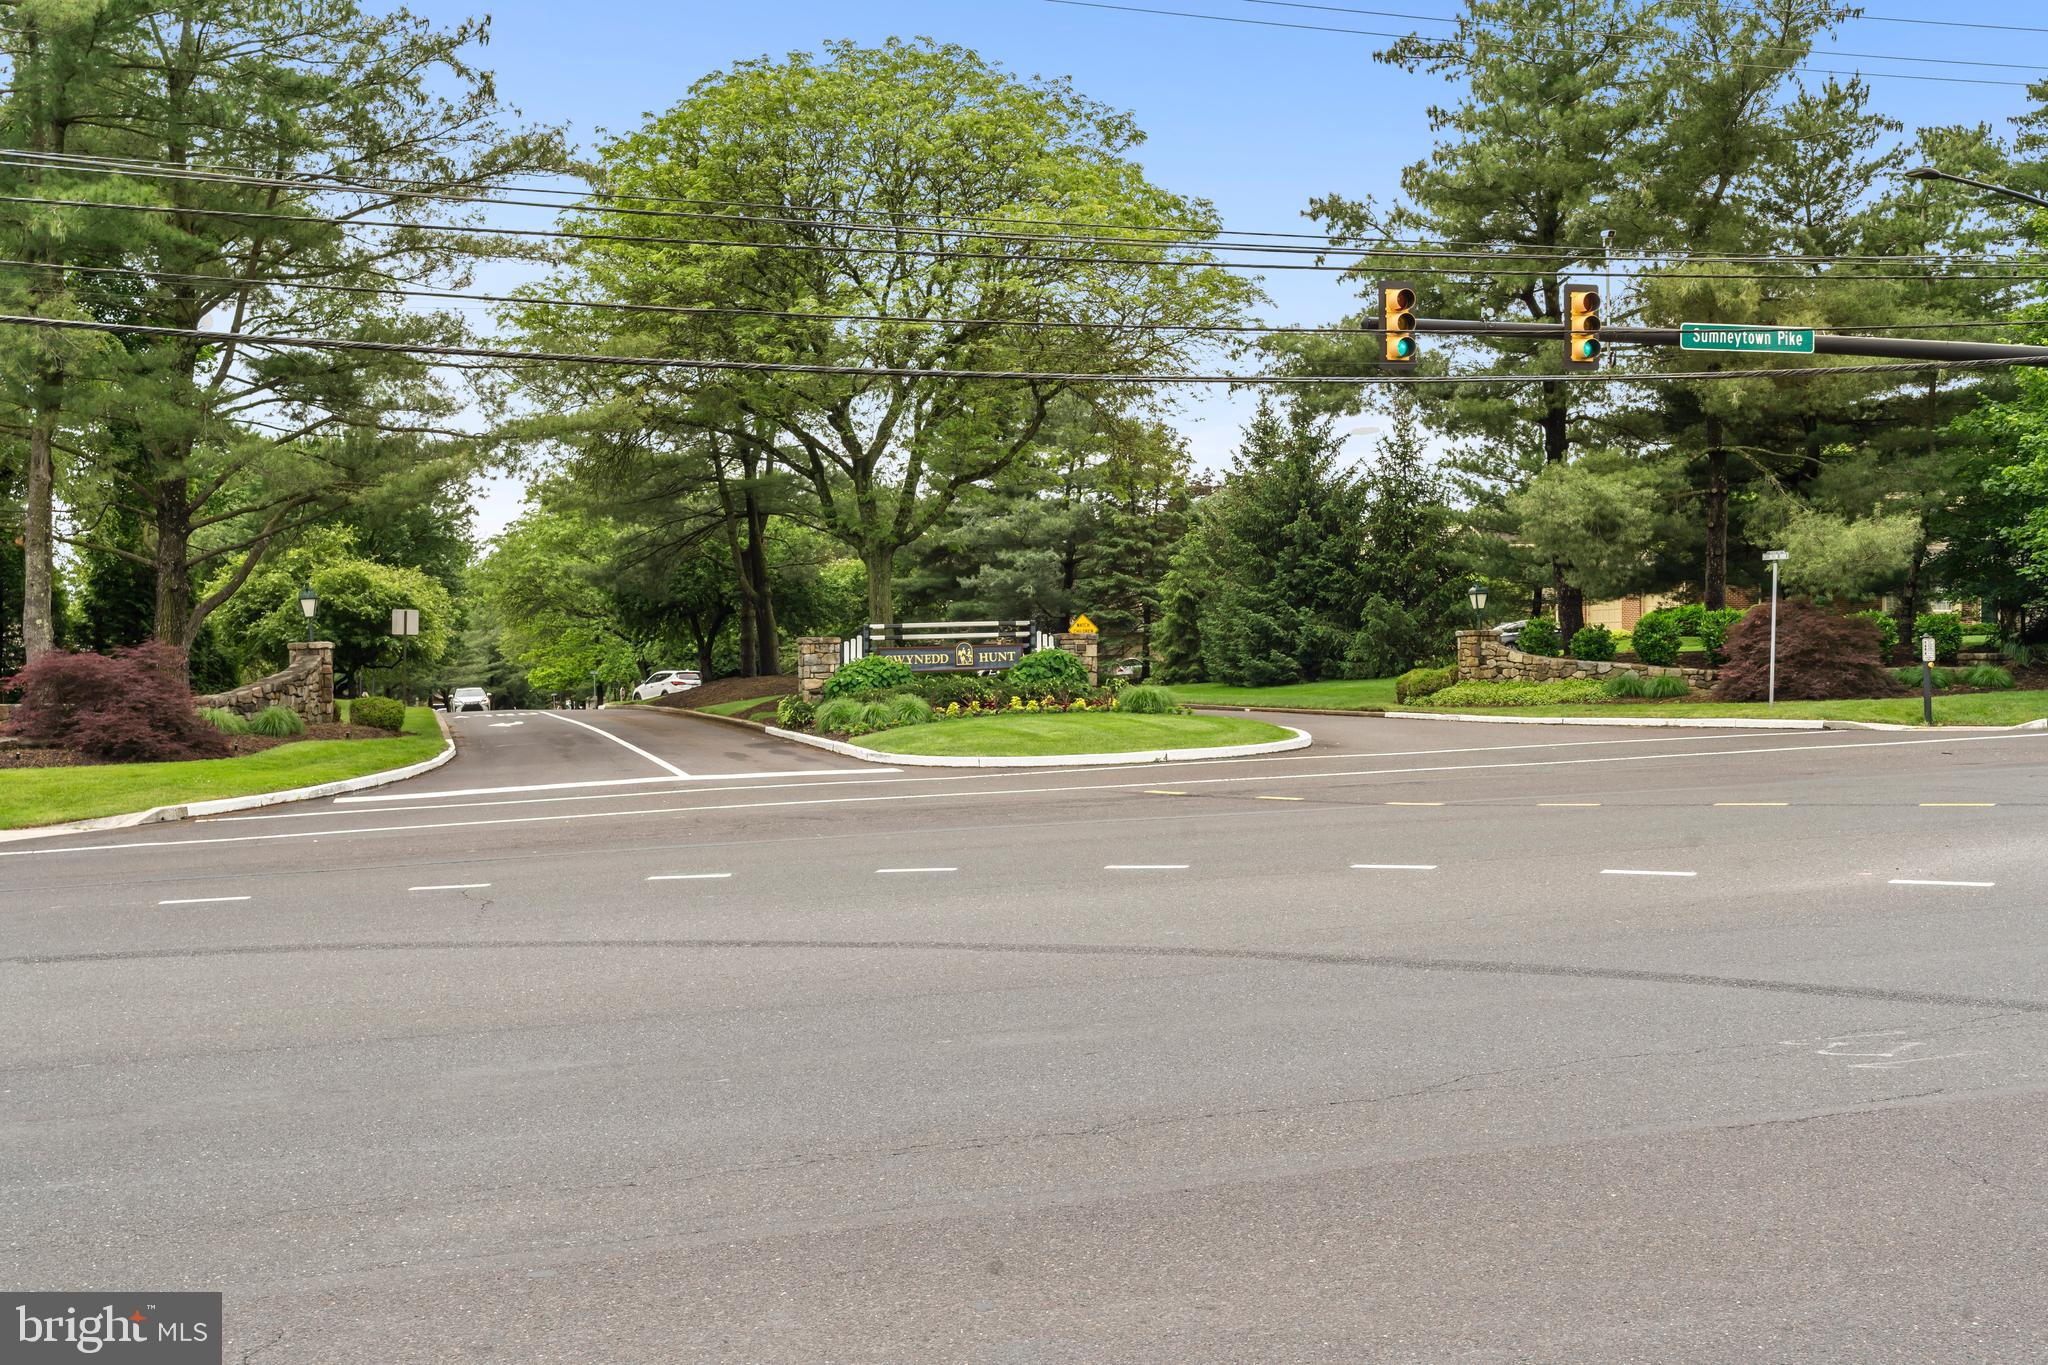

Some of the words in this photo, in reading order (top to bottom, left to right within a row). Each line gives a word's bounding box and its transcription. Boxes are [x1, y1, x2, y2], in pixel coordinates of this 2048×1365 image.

[1693, 328, 1771, 348] Sumneytown
[1777, 331, 1803, 346] Pike
[978, 651, 1016, 663] HUNT
